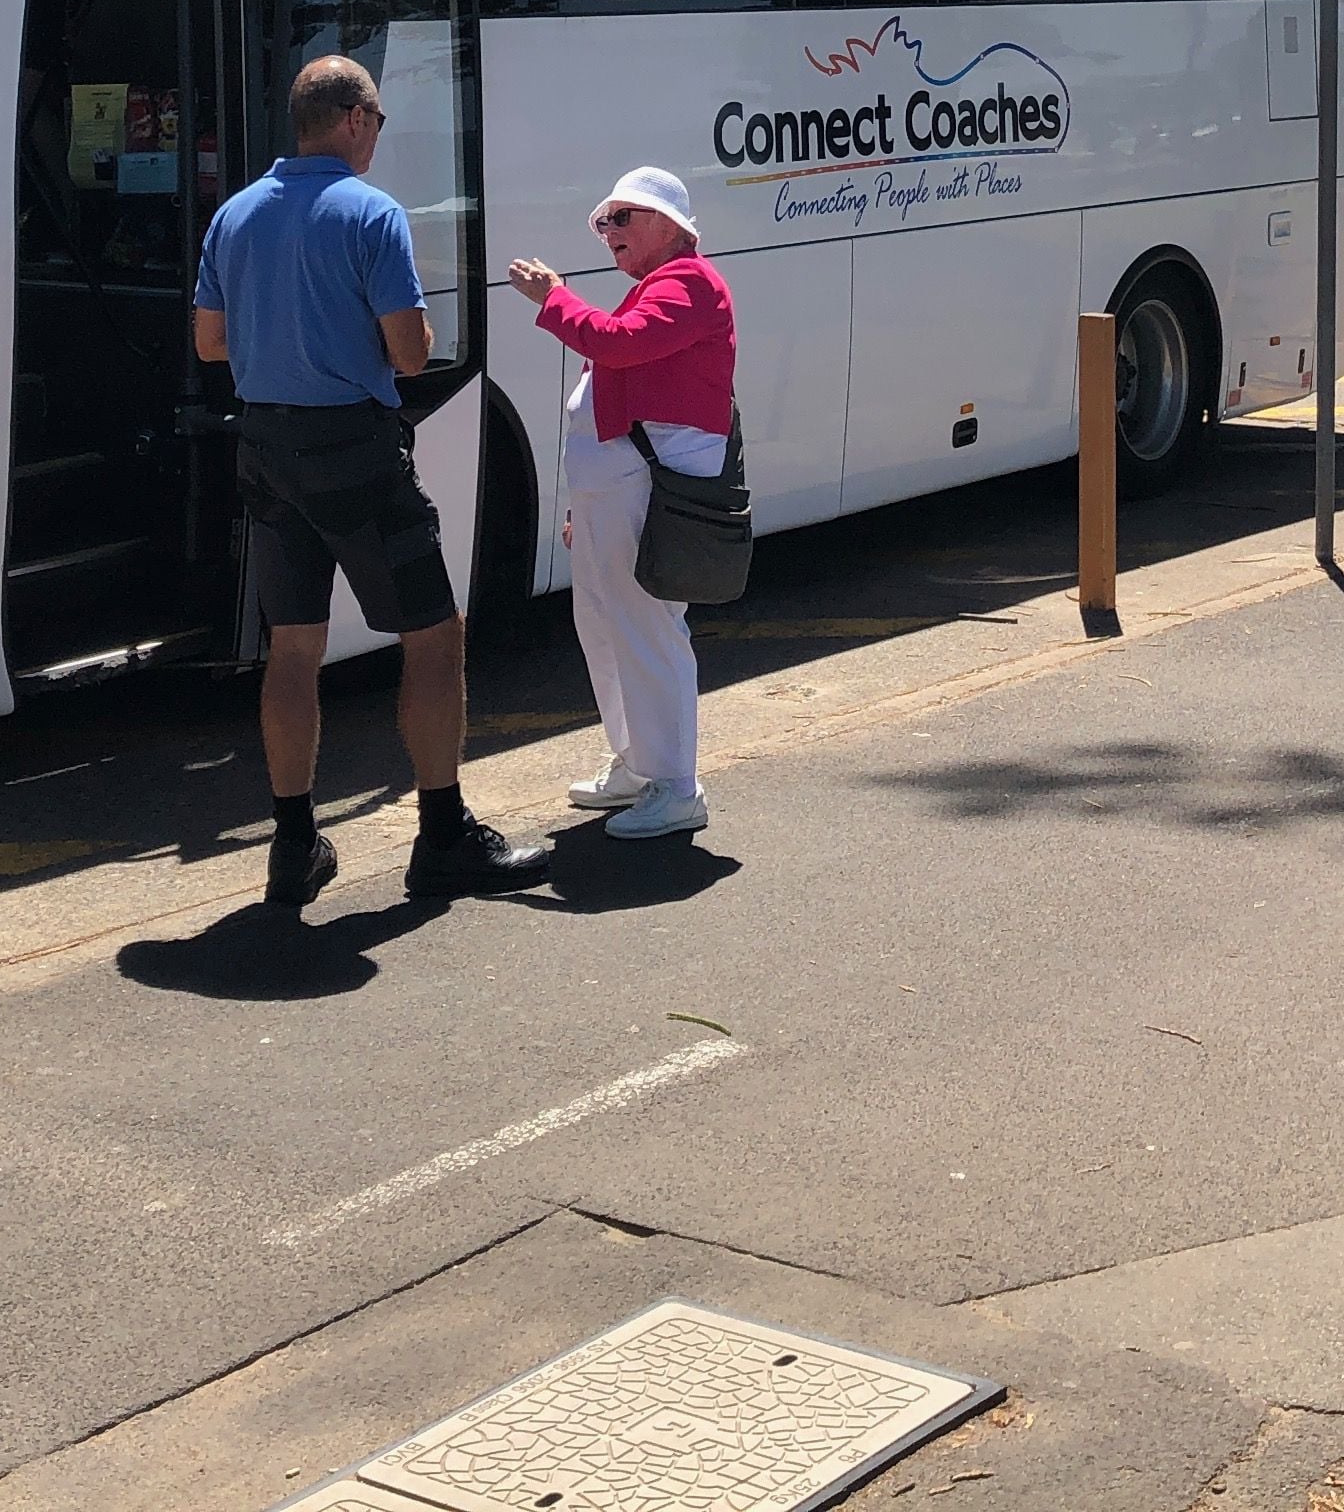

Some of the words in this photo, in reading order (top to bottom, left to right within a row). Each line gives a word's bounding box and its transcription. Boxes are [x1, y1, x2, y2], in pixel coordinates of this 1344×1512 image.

[713, 94, 895, 168] Connect
[906, 82, 1061, 151] Coaches
[774, 180, 870, 227] Connecting
[874, 168, 931, 221] People
[936, 165, 971, 201] with
[974, 161, 1023, 197] Places
[586, 1339, 613, 1353] AS
[457, 1412, 479, 1422] B
[838, 1448, 867, 1464] P6
